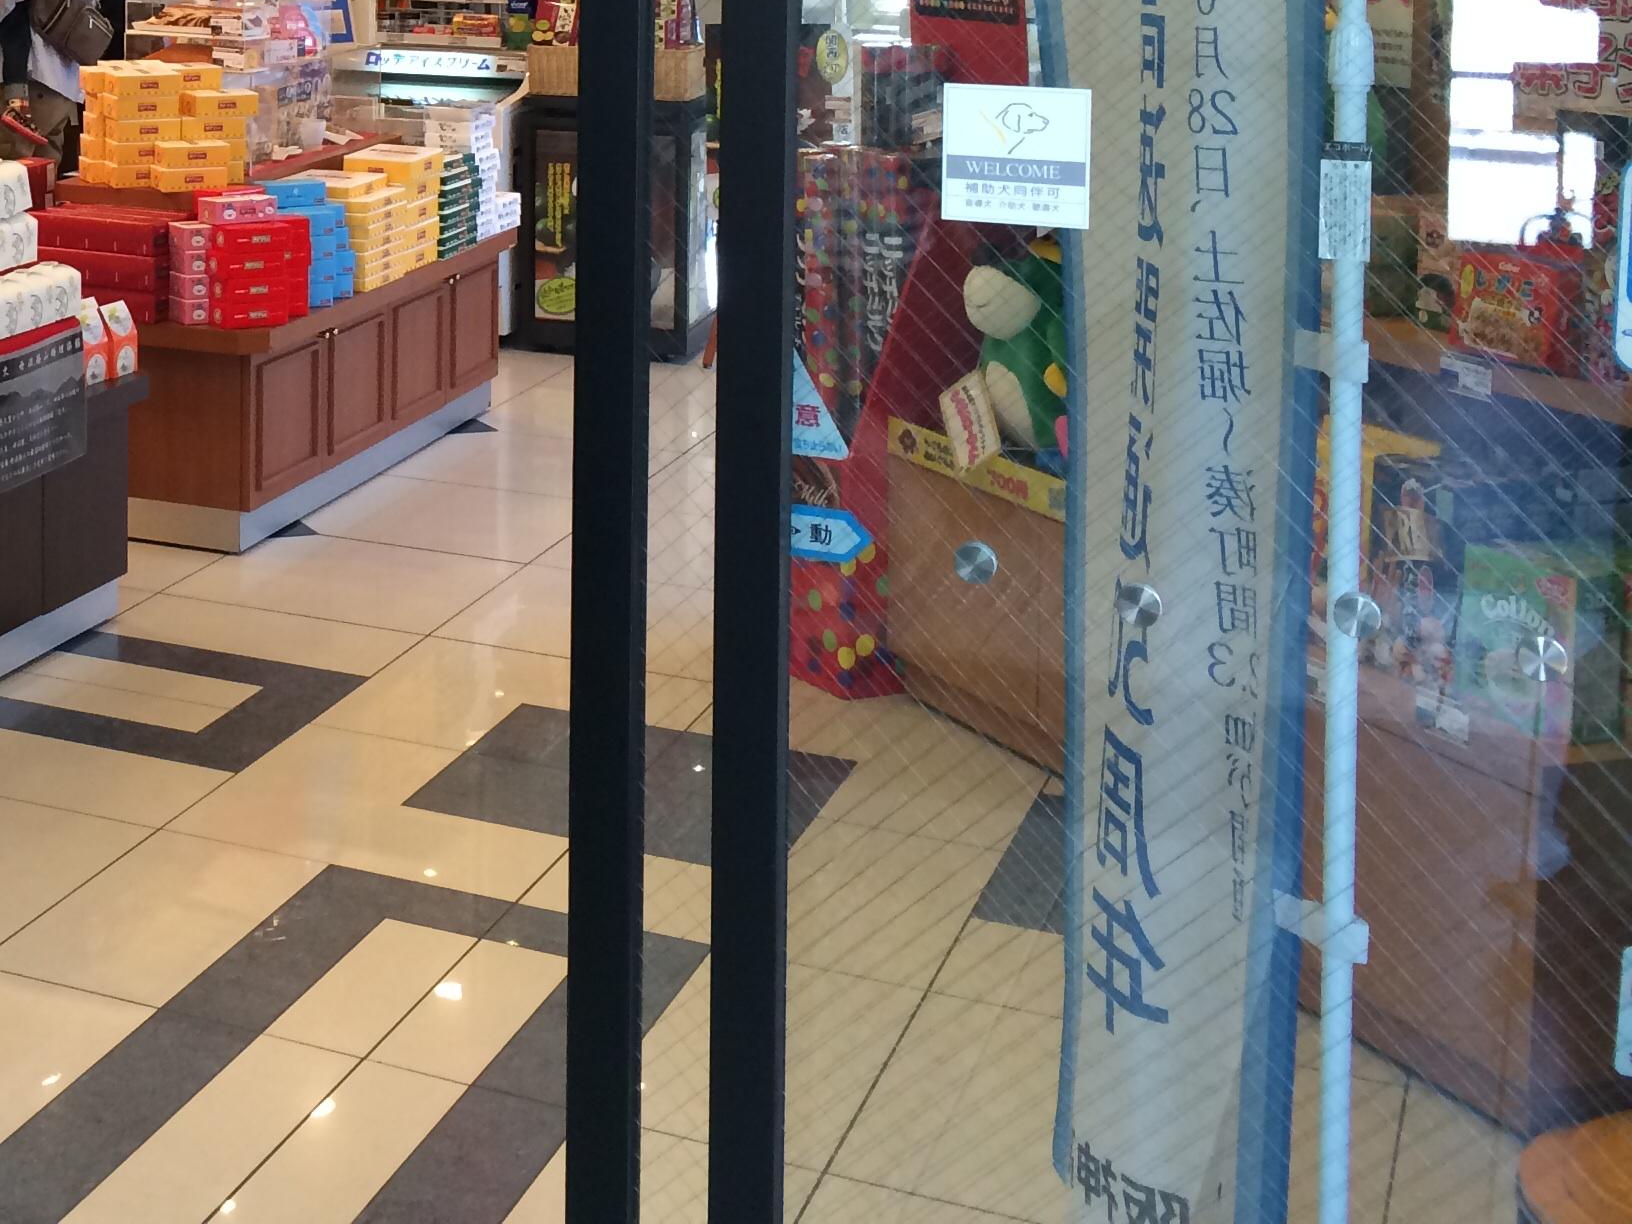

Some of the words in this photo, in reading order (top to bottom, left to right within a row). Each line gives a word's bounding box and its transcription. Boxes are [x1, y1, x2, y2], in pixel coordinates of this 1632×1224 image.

[365, 51, 491, 70] ロッテアイスクリーム
[965, 160, 1061, 179] WELCOME
[965, 182, 1060, 199] 補助犬同伴可
[809, 523, 833, 545] 動
